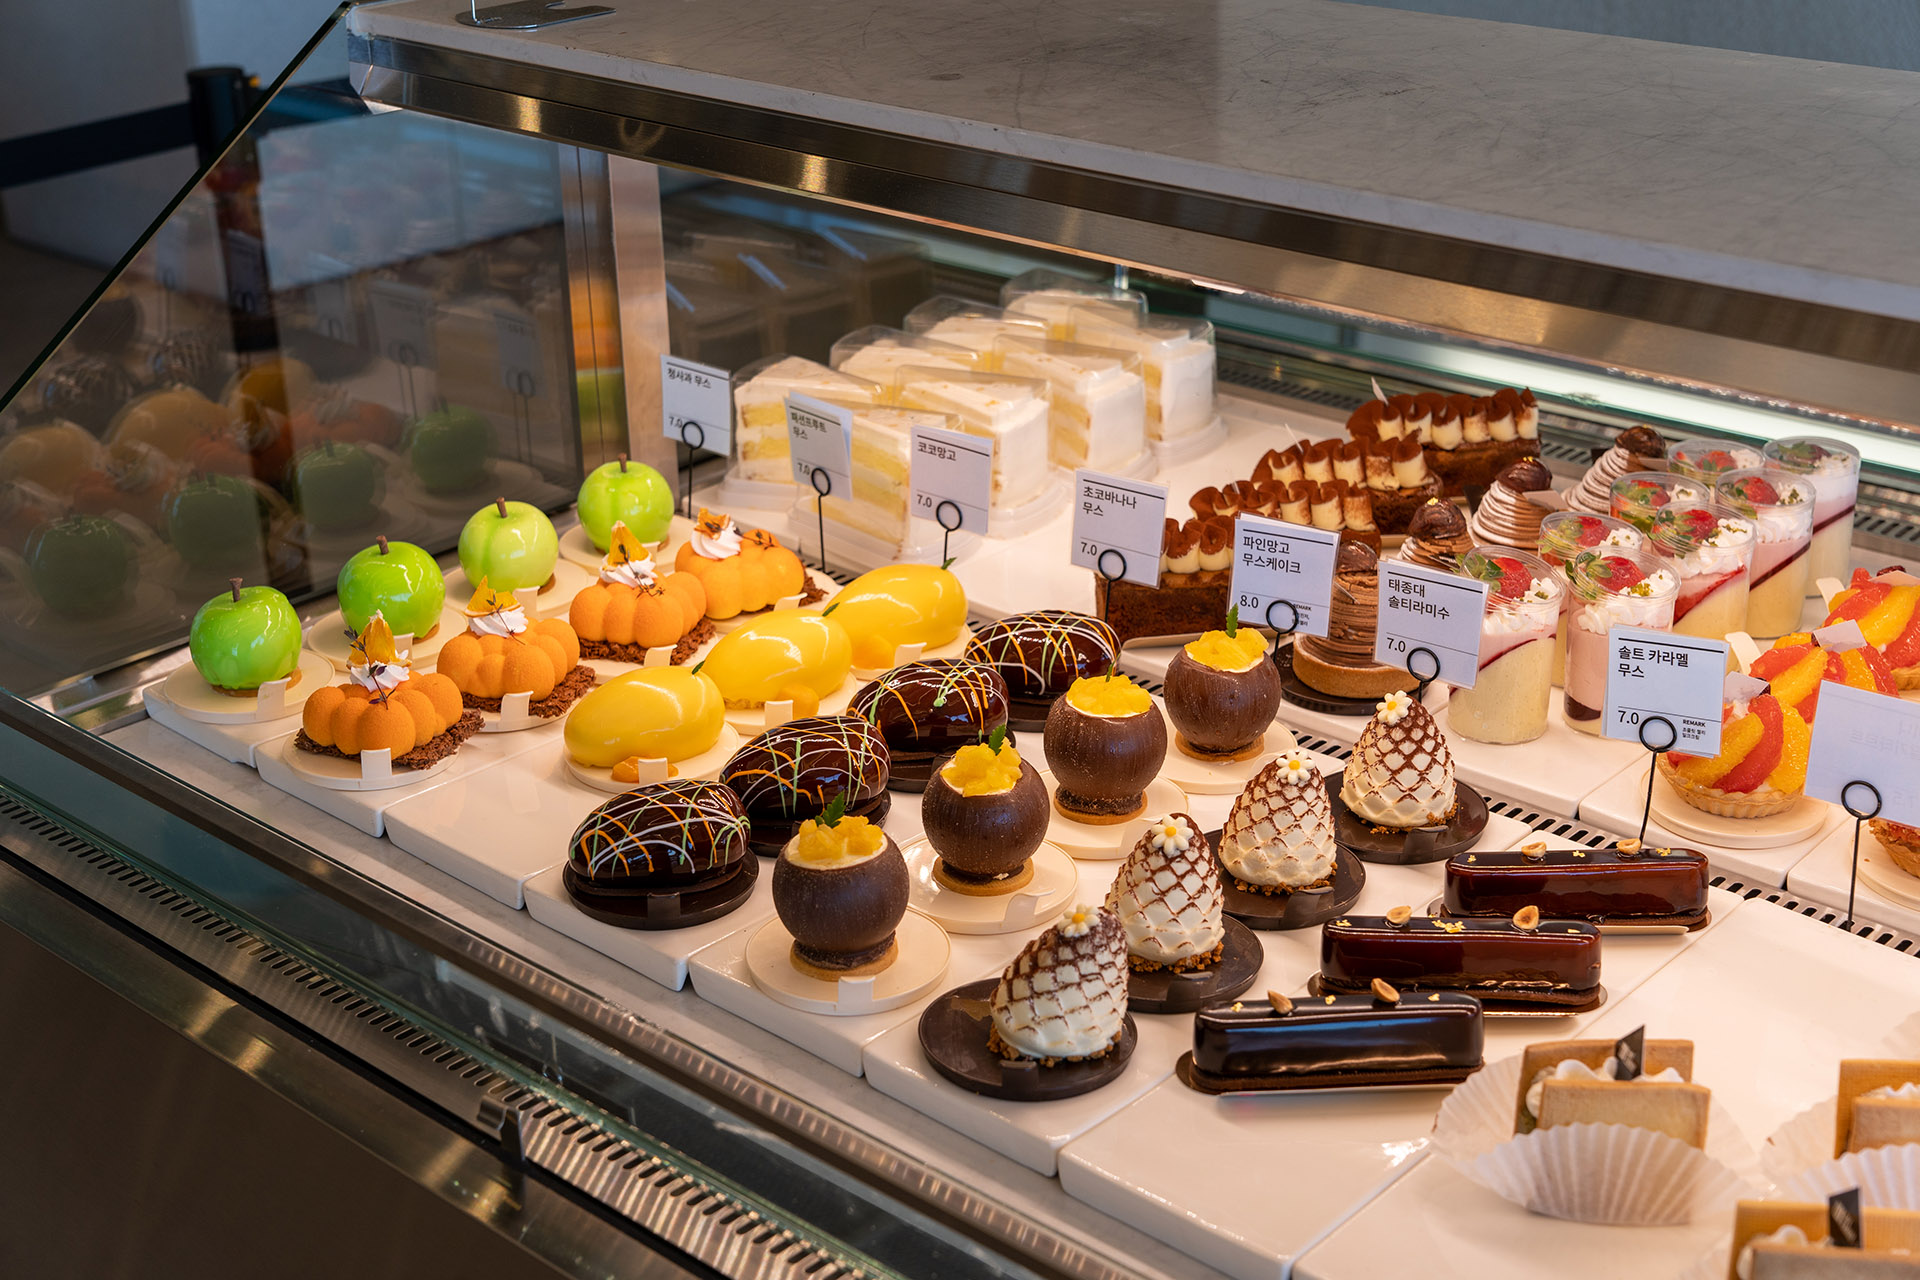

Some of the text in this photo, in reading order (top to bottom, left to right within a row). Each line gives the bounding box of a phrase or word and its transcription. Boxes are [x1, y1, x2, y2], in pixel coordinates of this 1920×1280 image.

[667, 367, 712, 389] 청사과 무스
[792, 425, 809, 440] 무스
[917, 441, 957, 462] 코코망고
[916, 494, 933, 508] 7.0
[1082, 485, 1137, 510] 초코바나나
[1082, 501, 1104, 517] 무스
[1080, 541, 1098, 556] 7.0
[1242, 535, 1291, 554] 파인망고
[1242, 552, 1302, 574] 무스케이크
[1388, 578, 1426, 598] 태종대
[1240, 594, 1259, 609] 8.0
[1387, 595, 1450, 620] 솔티라미수
[1386, 637, 1407, 653] 7.0
[1618, 645, 1689, 668] 솔트 카라멜
[1617, 663, 1645, 678] 무스
[1617, 710, 1640, 725] 7.0
[1682, 719, 1706, 727] REMARK
